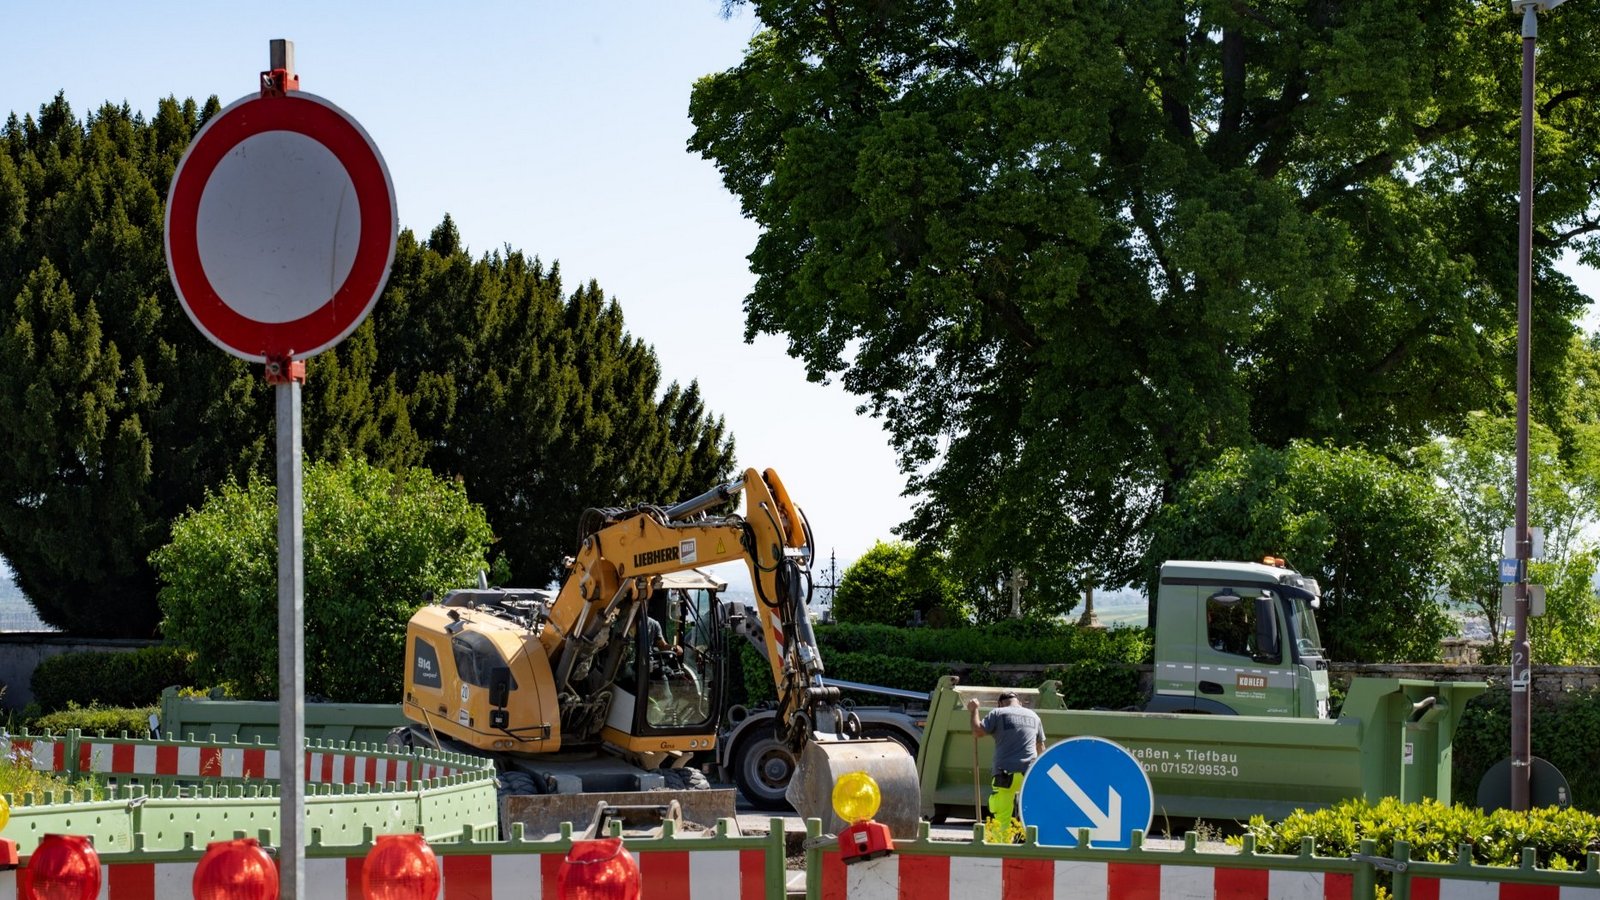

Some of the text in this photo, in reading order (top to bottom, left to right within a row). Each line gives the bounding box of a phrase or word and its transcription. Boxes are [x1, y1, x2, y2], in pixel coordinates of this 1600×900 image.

[634, 546, 680, 568] LIEBHERR
[418, 657, 431, 671] 914
[1515, 652, 1523, 666] 2
[461, 686, 468, 699] 20
[1186, 749, 1238, 763] Tiefbau
[1161, 762, 1239, 777] 07152/9953-0
